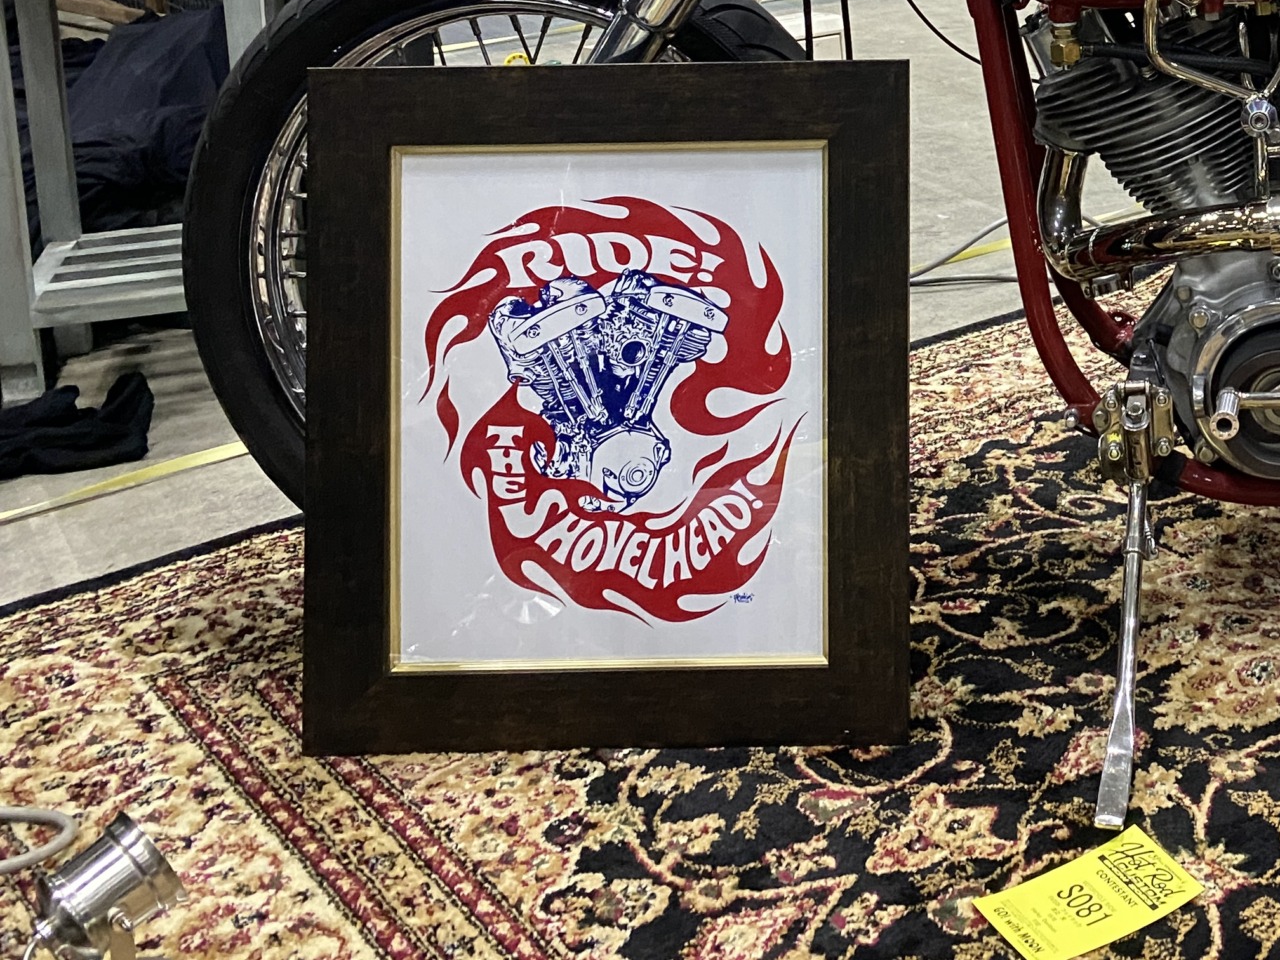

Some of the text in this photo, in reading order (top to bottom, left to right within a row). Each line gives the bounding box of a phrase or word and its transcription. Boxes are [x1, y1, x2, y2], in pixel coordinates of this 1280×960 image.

[494, 231, 725, 289] RIDE!
[486, 425, 526, 500] THE
[1096, 869, 1139, 908] CONTESTANT
[1107, 842, 1158, 871] Hot
[1143, 867, 1186, 898] Rod
[1116, 862, 1168, 905] CUSTOM
[1056, 884, 1113, 927] S081
[993, 906, 1011, 920] GO!
[1005, 919, 1025, 934] with
[1018, 932, 1046, 954] MOON
